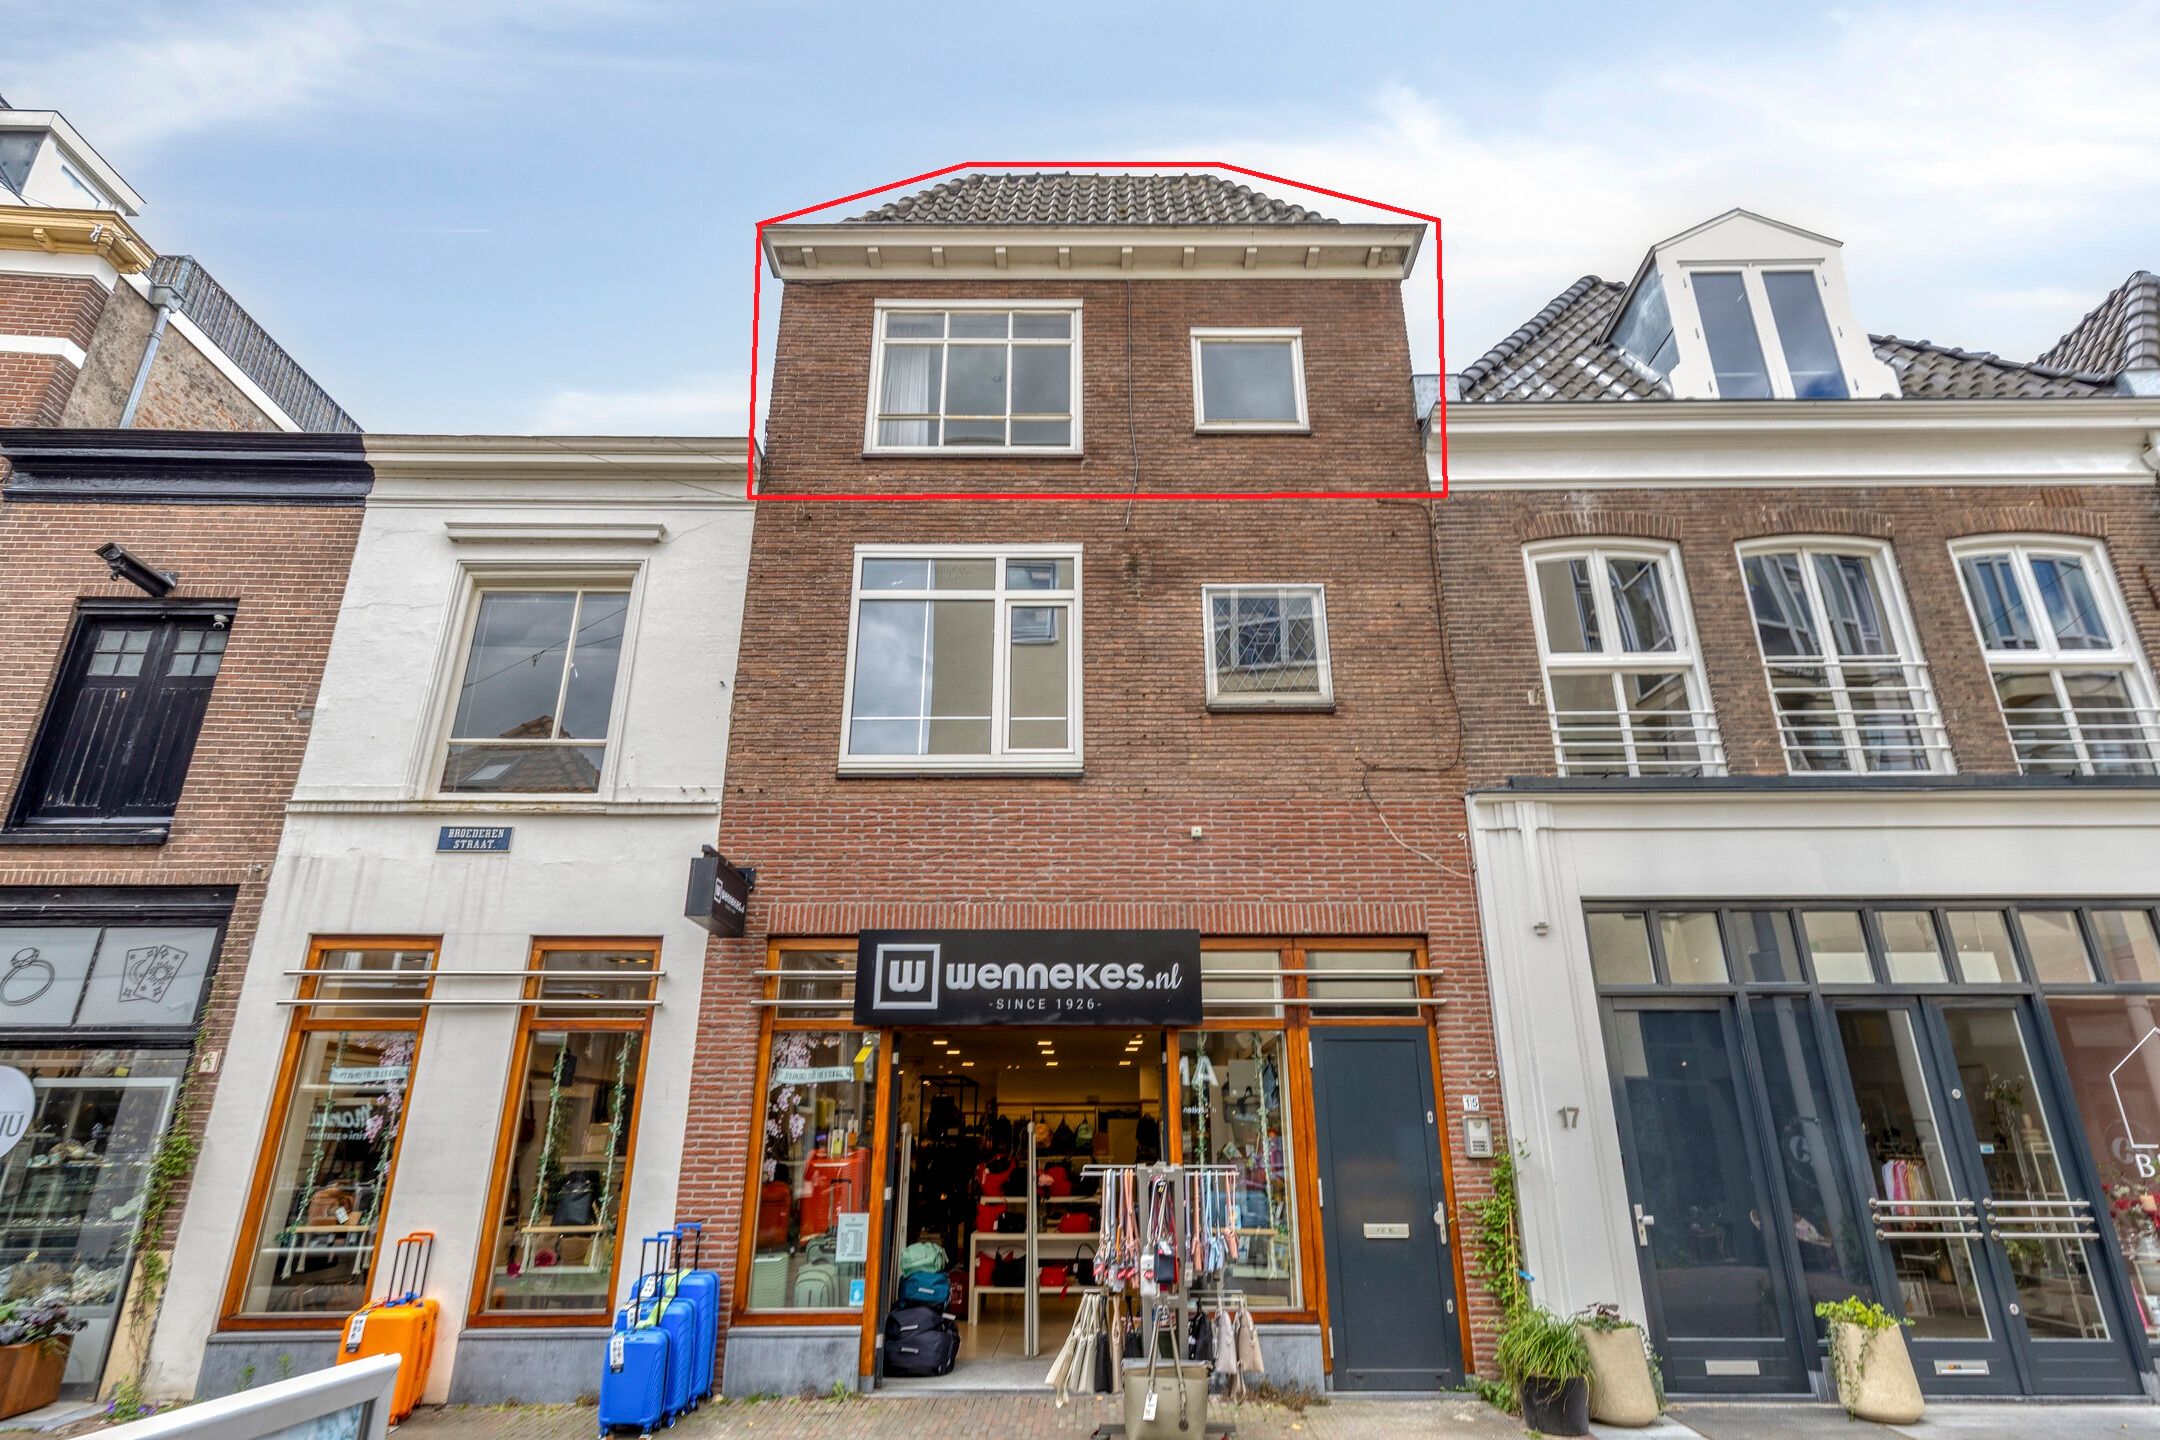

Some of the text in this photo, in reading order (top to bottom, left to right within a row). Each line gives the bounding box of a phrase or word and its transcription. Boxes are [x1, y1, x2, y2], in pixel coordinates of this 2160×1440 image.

[447, 828, 505, 838] BROEDEREN
[945, 962, 1183, 991] wennekes.nl
[1558, 1106, 1579, 1129] 17
